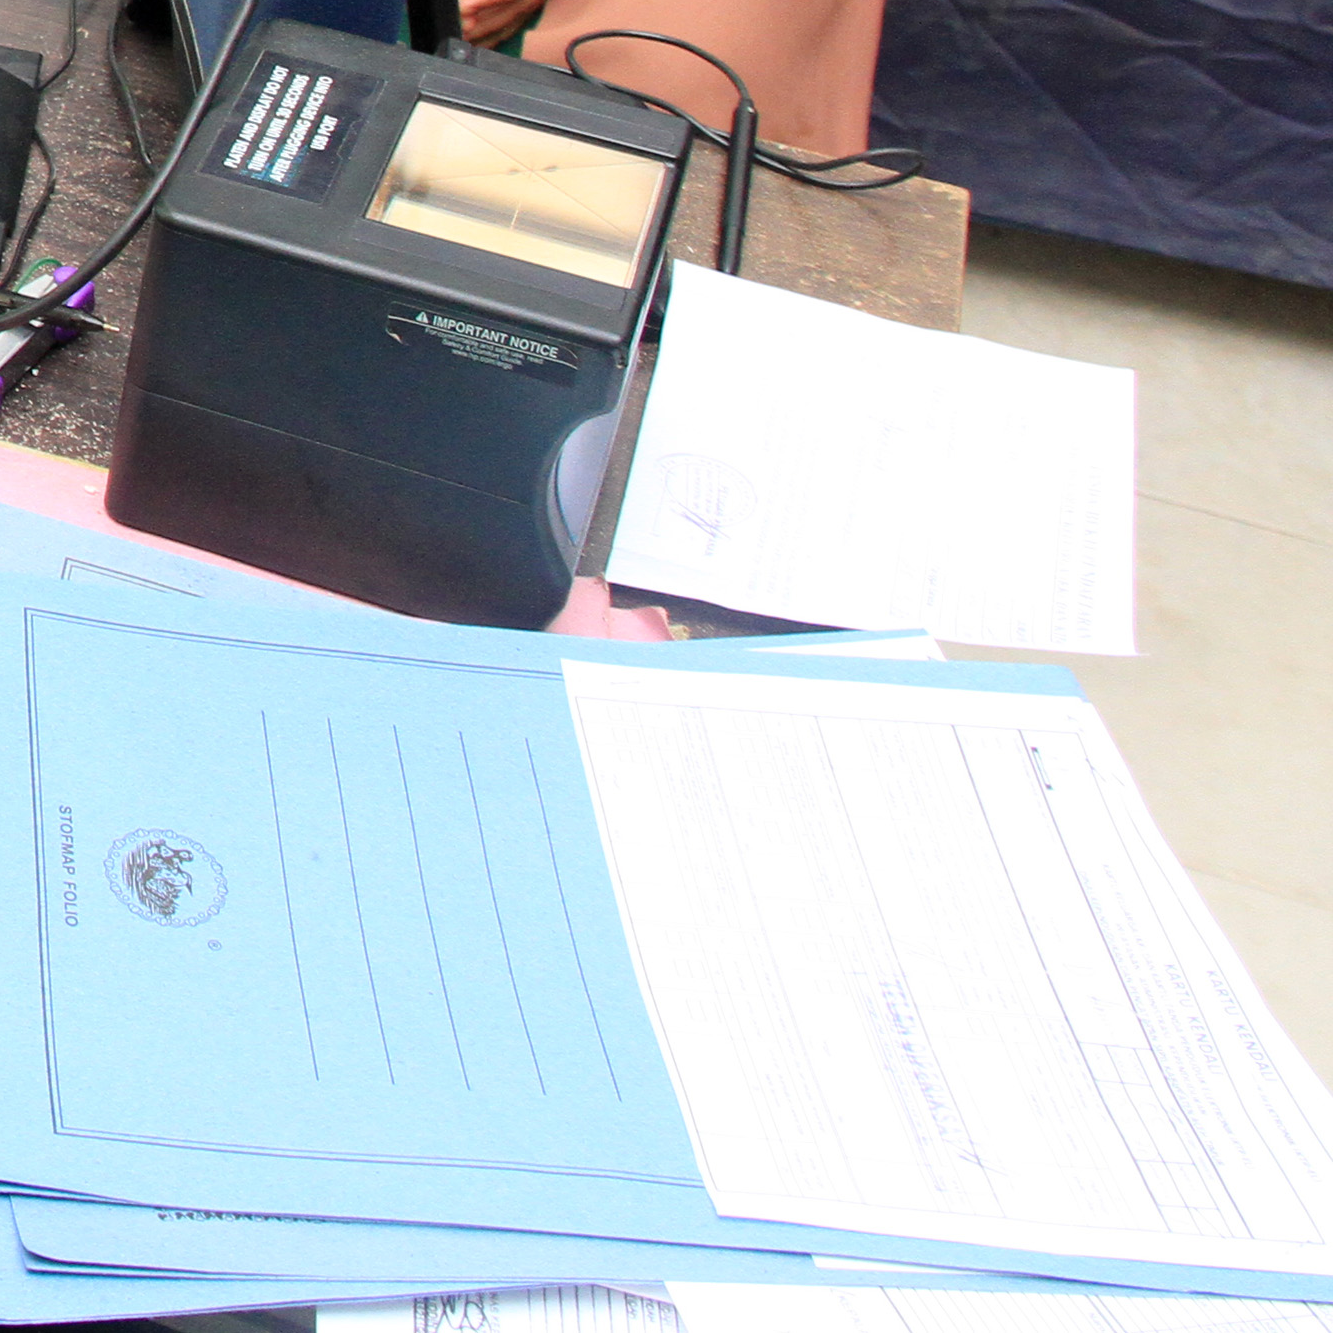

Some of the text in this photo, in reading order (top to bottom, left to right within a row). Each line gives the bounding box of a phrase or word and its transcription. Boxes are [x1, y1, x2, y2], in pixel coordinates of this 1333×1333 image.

[223, 66, 289, 168] PLATEN AND DISPLAY DO NOT
[247, 74, 310, 171] TURN ON UNTIL 30 SECONDS
[269, 75, 333, 183] AFTER PLUGGING DEVICE INTO
[310, 115, 338, 151] USB PORT
[433, 315, 559, 359] IMPORTANT NOTICE
[59, 805, 78, 927] STOFMAP FOLIO
[1165, 964, 1224, 1076] KARTU KENDALI
[1205, 969, 1278, 1082] KARTU KENDALI
